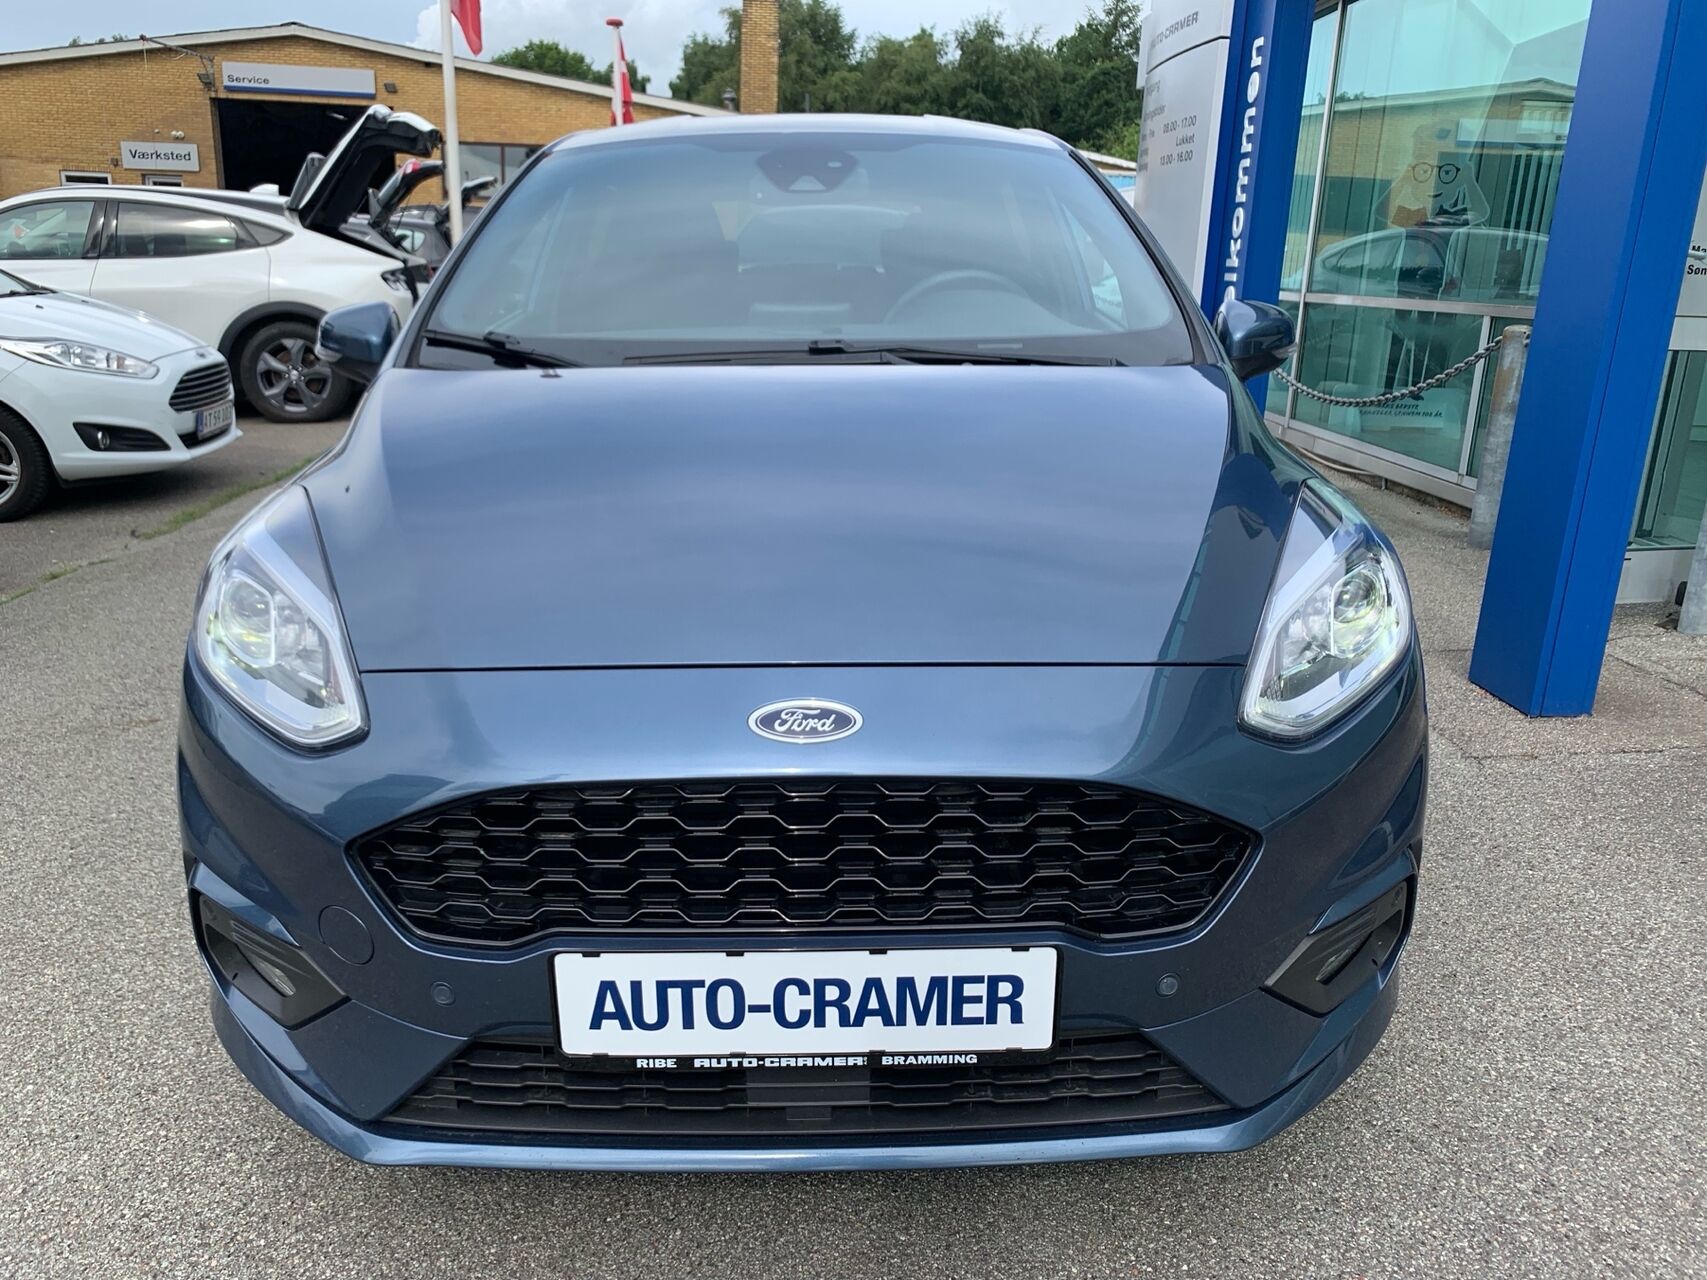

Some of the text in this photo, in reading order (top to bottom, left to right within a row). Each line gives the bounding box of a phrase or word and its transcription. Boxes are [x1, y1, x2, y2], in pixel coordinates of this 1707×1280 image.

[227, 74, 270, 85] Service
[1175, 133, 1195, 147] Lukket
[129, 149, 192, 161] Værksted
[774, 708, 836, 732] Ford
[588, 974, 1025, 1031] AUTO-CRAMER
[636, 1058, 677, 1068] RIBE
[694, 1056, 864, 1068] AUTO-CRAMER
[881, 1054, 977, 1065] BRAMMING
